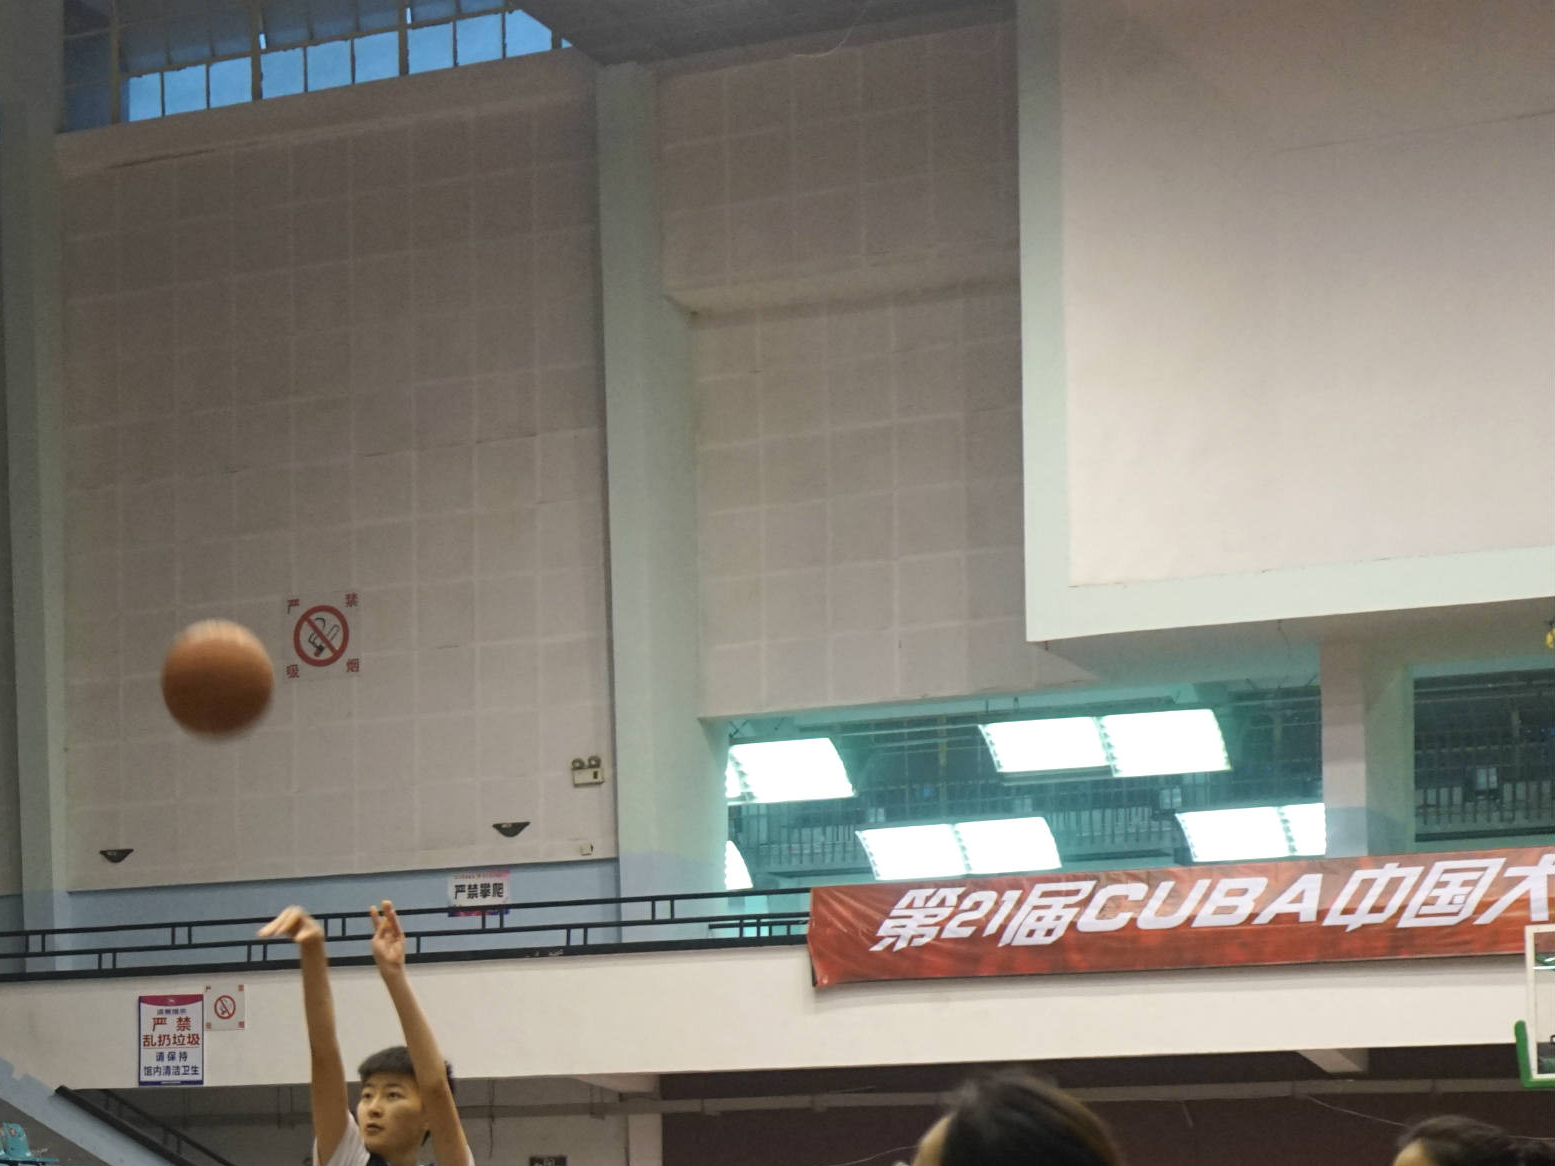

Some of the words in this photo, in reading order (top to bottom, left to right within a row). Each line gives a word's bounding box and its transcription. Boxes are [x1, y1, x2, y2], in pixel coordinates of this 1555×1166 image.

[454, 882, 504, 900] 严禁攀爬
[152, 1016, 191, 1032] 严禁
[142, 1033, 201, 1047] 乱扔垃圾
[156, 1051, 188, 1062] 请保持
[144, 1065, 201, 1077] 馆内清洁卫生
